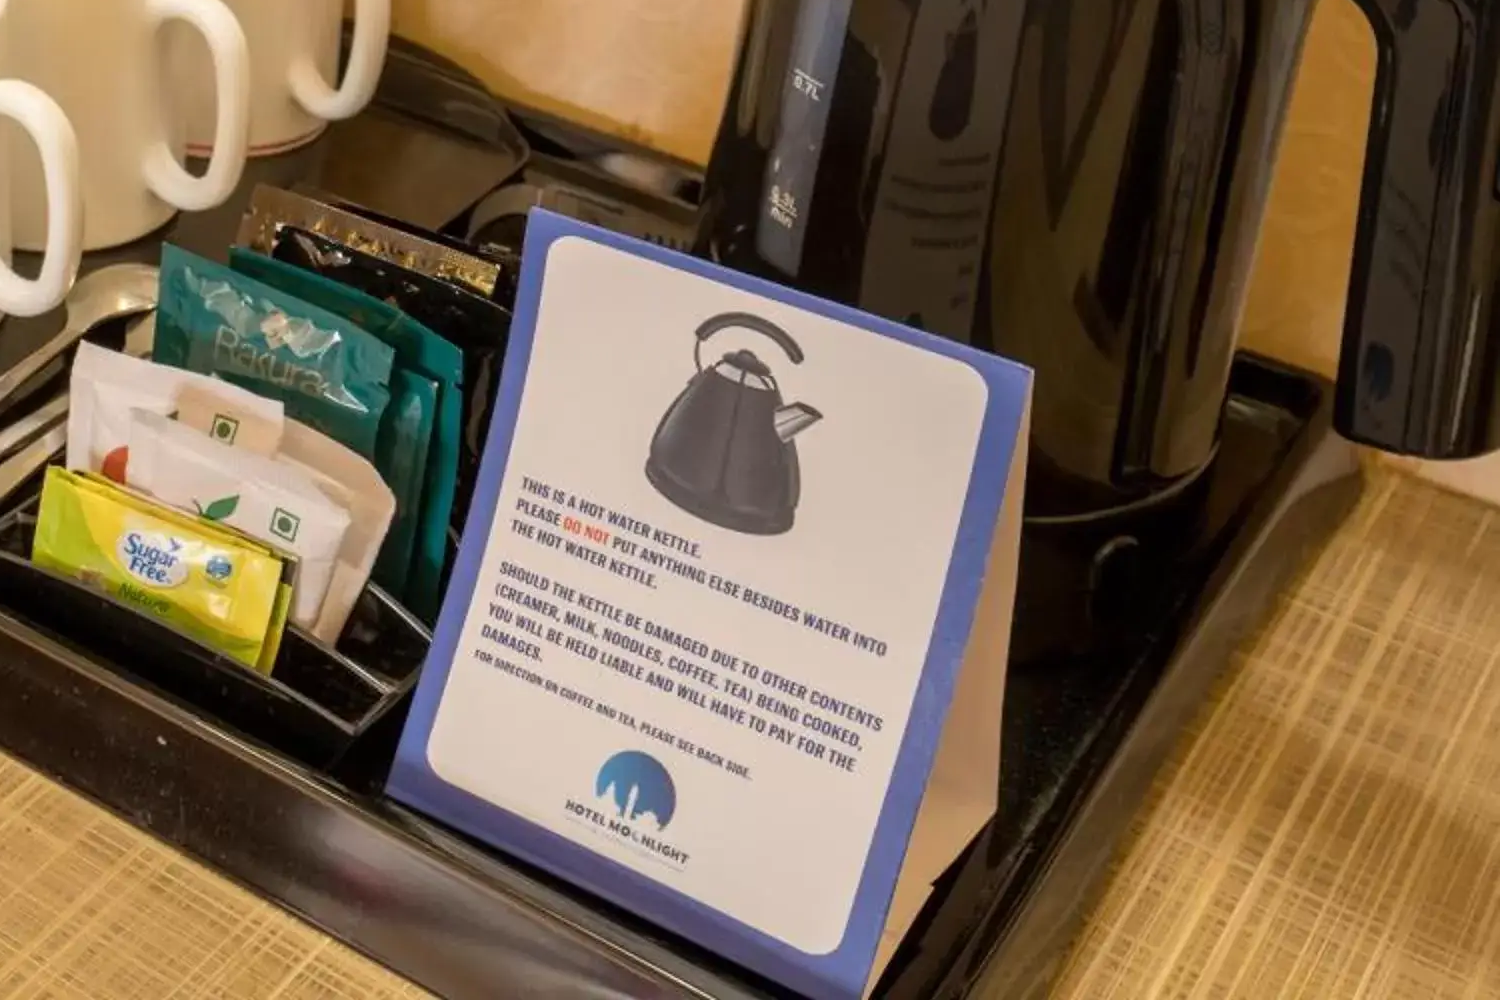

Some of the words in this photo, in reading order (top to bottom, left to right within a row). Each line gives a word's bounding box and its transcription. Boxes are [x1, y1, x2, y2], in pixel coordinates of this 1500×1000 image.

[124, 533, 179, 568] Sugar
[511, 519, 538, 539] THE
[537, 530, 562, 549] HOT
[564, 541, 608, 567] WATER
[609, 559, 657, 589] KETTLE.
[522, 476, 551, 499] THIS
[553, 489, 565, 505] IS
[567, 496, 576, 509] A
[579, 501, 605, 519] HOT
[607, 510, 652, 538] WATER
[653, 528, 701, 559] KETTLE.
[130, 557, 167, 583] Free
[516, 498, 561, 526] PLEASE
[562, 516, 581, 535] DO
[584, 525, 610, 546] NOT
[612, 536, 638, 557] PUT
[639, 547, 706, 585] ANYTHING
[708, 575, 740, 599] ELSE
[742, 587, 800, 622] BESIDES
[802, 611, 850, 643] WATER
[853, 631, 887, 657] INTO
[480, 623, 543, 662] DAMAGES.
[494, 583, 561, 622] (CREAMER,
[563, 610, 599, 638] MILK,
[601, 627, 664, 667] NOODLES,
[667, 655, 719, 690] COFFEE,
[723, 678, 753, 704] TEA)
[756, 693, 800, 722] BEING
[801, 712, 863, 752] COOKED,
[500, 561, 550, 591] SHOULD
[552, 581, 577, 602] THE
[577, 593, 624, 623] KETTLE
[625, 612, 643, 631] BE
[644, 621, 709, 658] DAMAGED
[711, 649, 740, 672] DUE
[741, 660, 759, 679] TO
[761, 669, 807, 700] OTHER
[809, 690, 884, 732] CONTENTS
[474, 649, 493, 665] FOR
[493, 658, 544, 686] DIRECTION
[545, 679, 559, 694] ON
[559, 687, 594, 711] COFFEE
[596, 702, 617, 719] AND
[639, 721, 675, 747] PLEASE
[676, 738, 695, 755] SEE
[696, 747, 725, 768] BACK
[488, 601, 513, 623] YOU
[515, 614, 543, 638] WILL
[545, 628, 564, 646] BE
[565, 635, 599, 661] HELD
[599, 650, 645, 680] LIABLE
[645, 671, 675, 693] AND
[677, 683, 707, 709] WILL
[709, 698, 746, 724] HAVE
[748, 714, 767, 734] TO
[767, 723, 796, 745] PAY
[797, 735, 827, 760] FOR
[828, 748, 858, 773] THE
[565, 799, 606, 827] HOTEL
